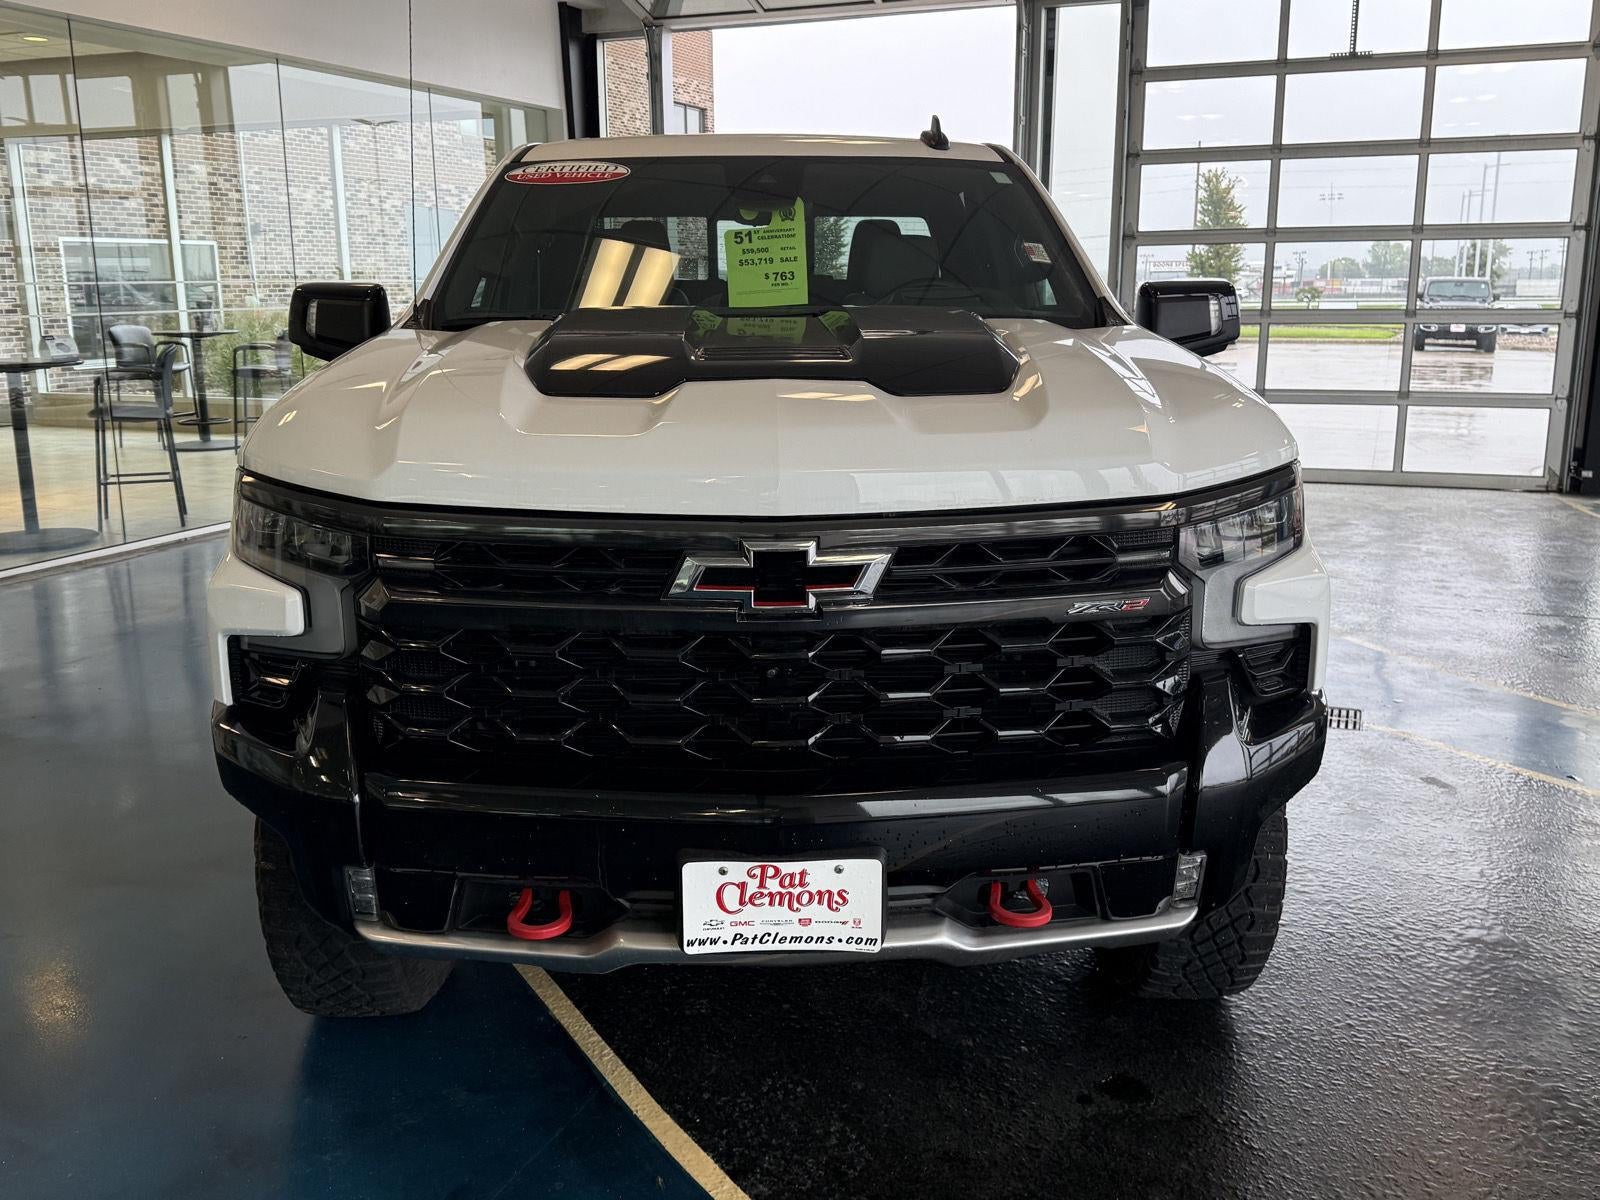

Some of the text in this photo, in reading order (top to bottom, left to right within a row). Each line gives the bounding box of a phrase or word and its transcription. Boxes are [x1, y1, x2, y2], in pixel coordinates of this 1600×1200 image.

[522, 164, 618, 173] CERTIFIED
[734, 230, 753, 245] 51
[738, 257, 774, 267] $53,719
[764, 271, 795, 281] $ 763
[746, 864, 811, 890] Pat
[715, 881, 850, 915] Clemons
